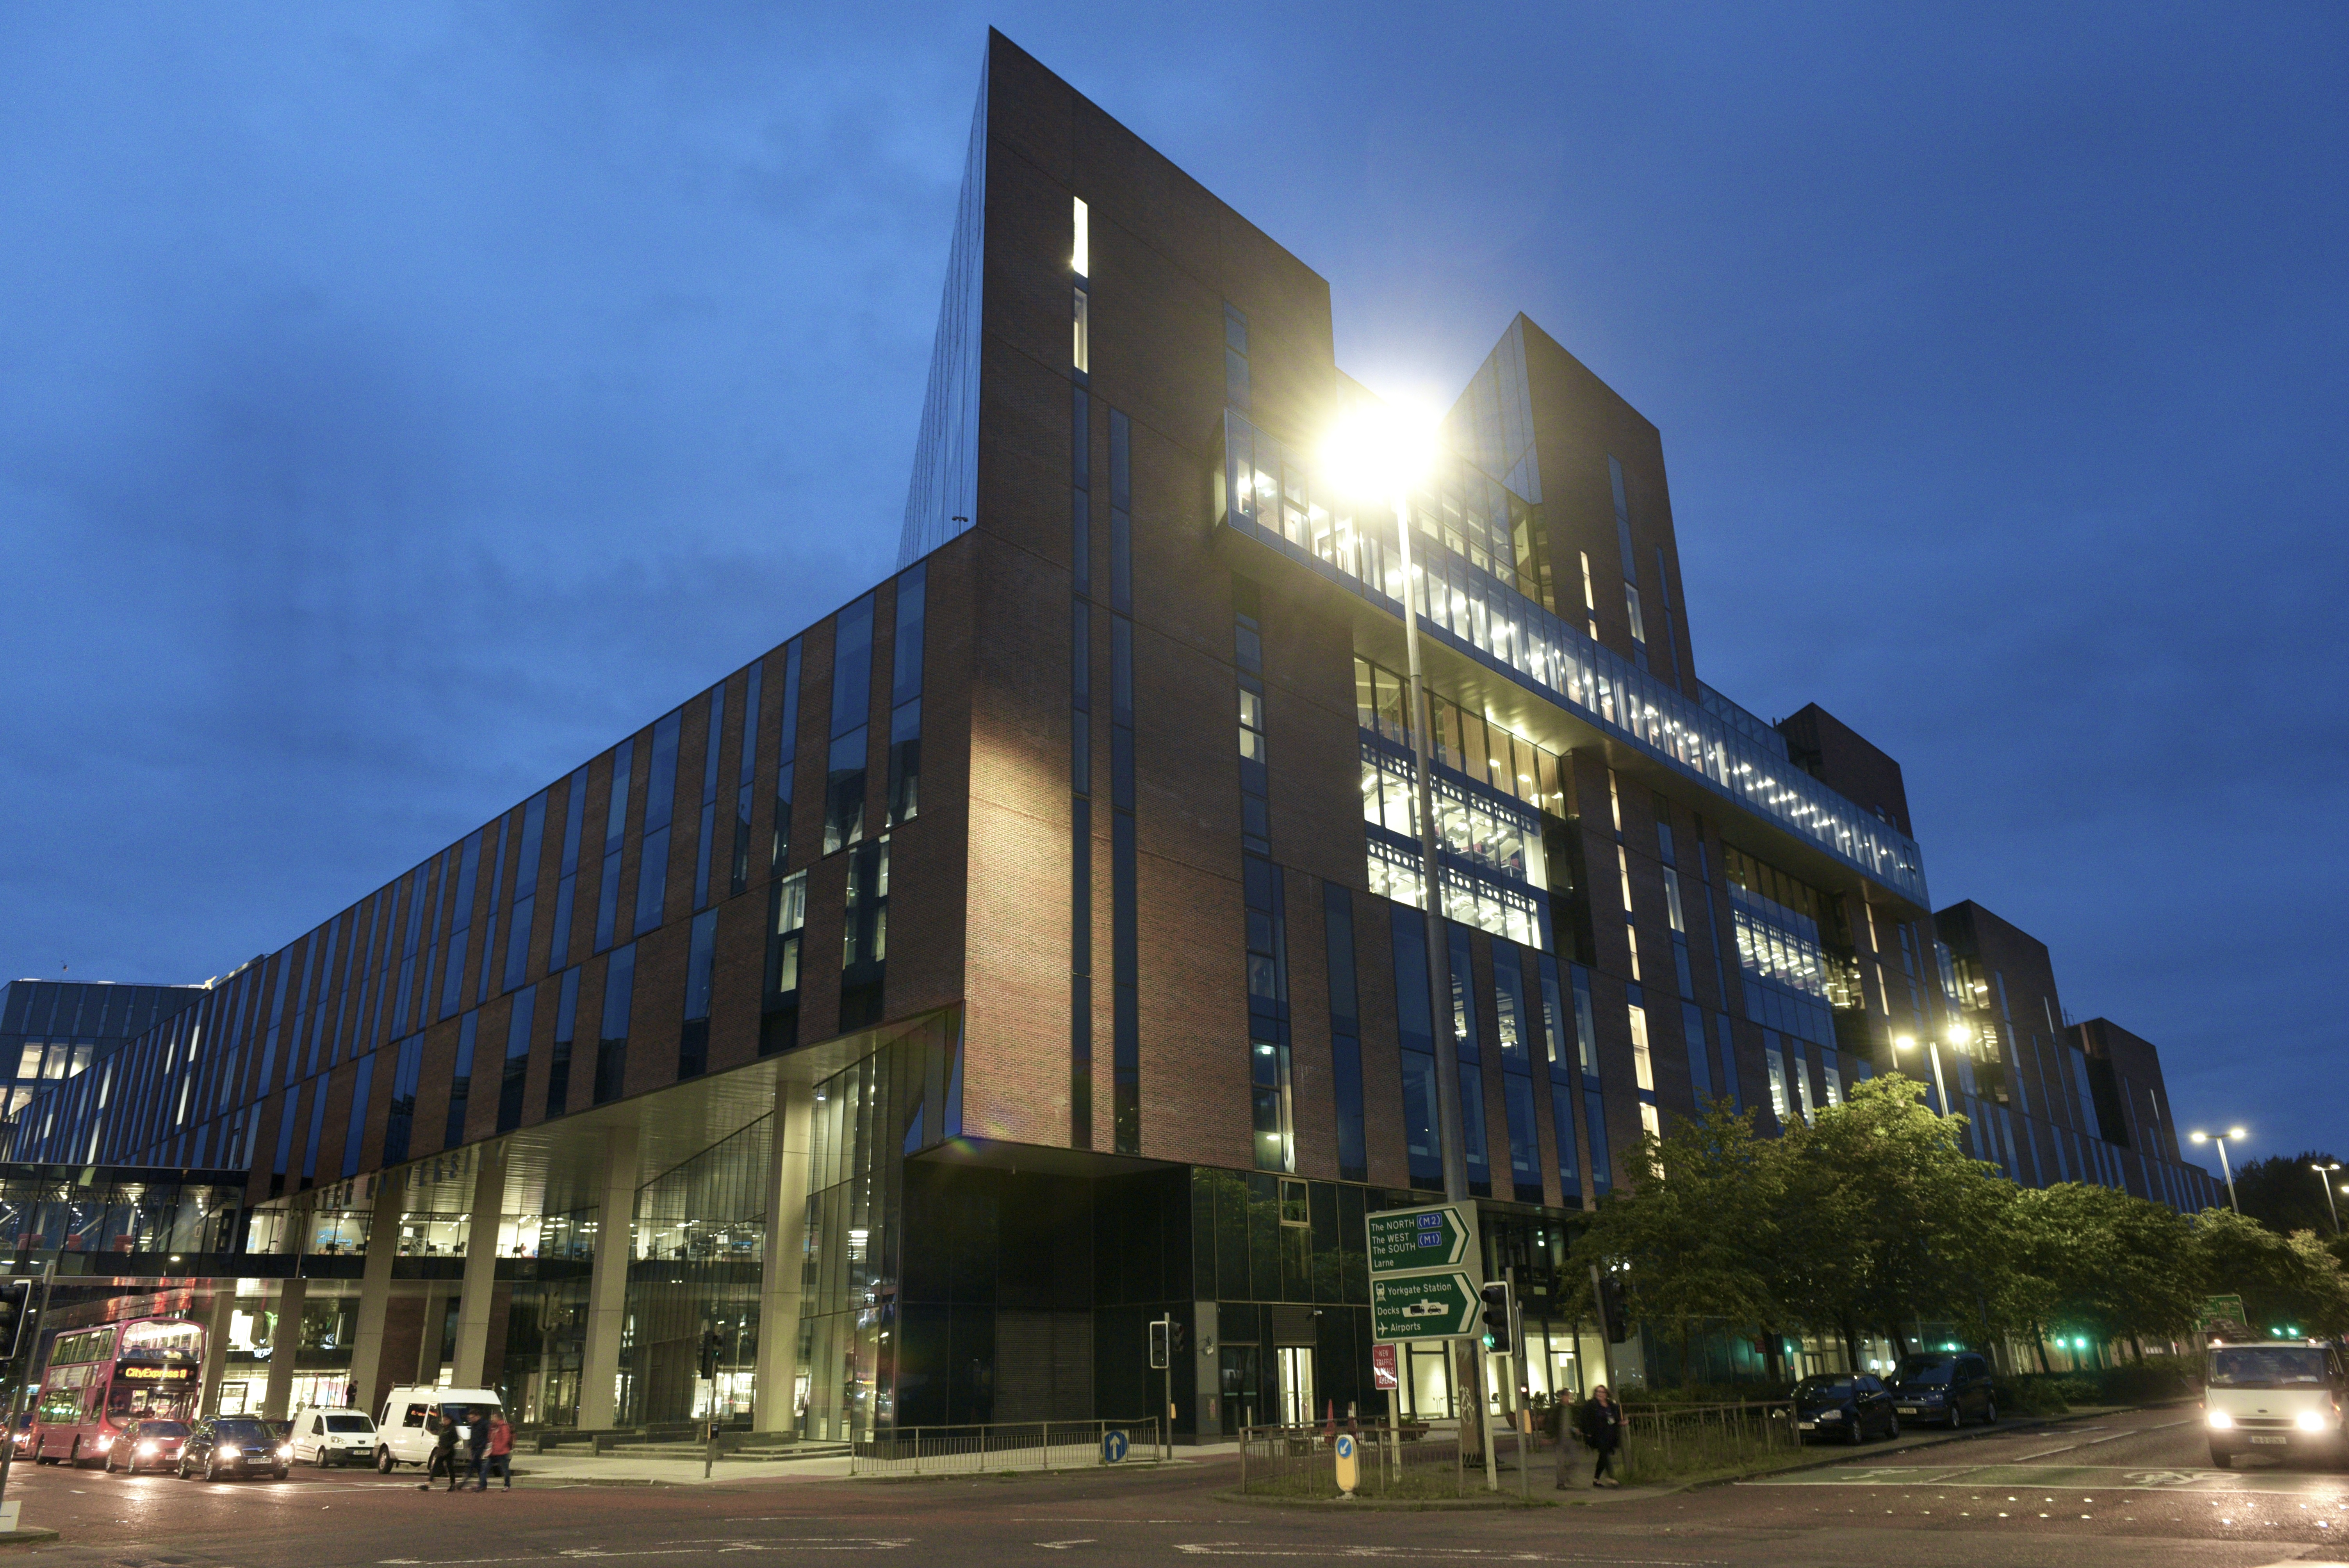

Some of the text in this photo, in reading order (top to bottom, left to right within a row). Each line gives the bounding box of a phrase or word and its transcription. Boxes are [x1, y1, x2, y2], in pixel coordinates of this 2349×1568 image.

[1371, 1214, 1441, 1232] The NORTH (M2)
[1372, 1232, 1409, 1245] The WEST
[1419, 1233, 1440, 1245] (M1)
[1372, 1242, 1416, 1255] The SOUTH
[1374, 1259, 1394, 1268] Larne
[1387, 1282, 1452, 1296] Yorkgate Station
[1377, 1306, 1400, 1315] Docks
[1390, 1322, 1421, 1333] Airports
[1376, 1358, 1393, 1367] TRAFFIC
